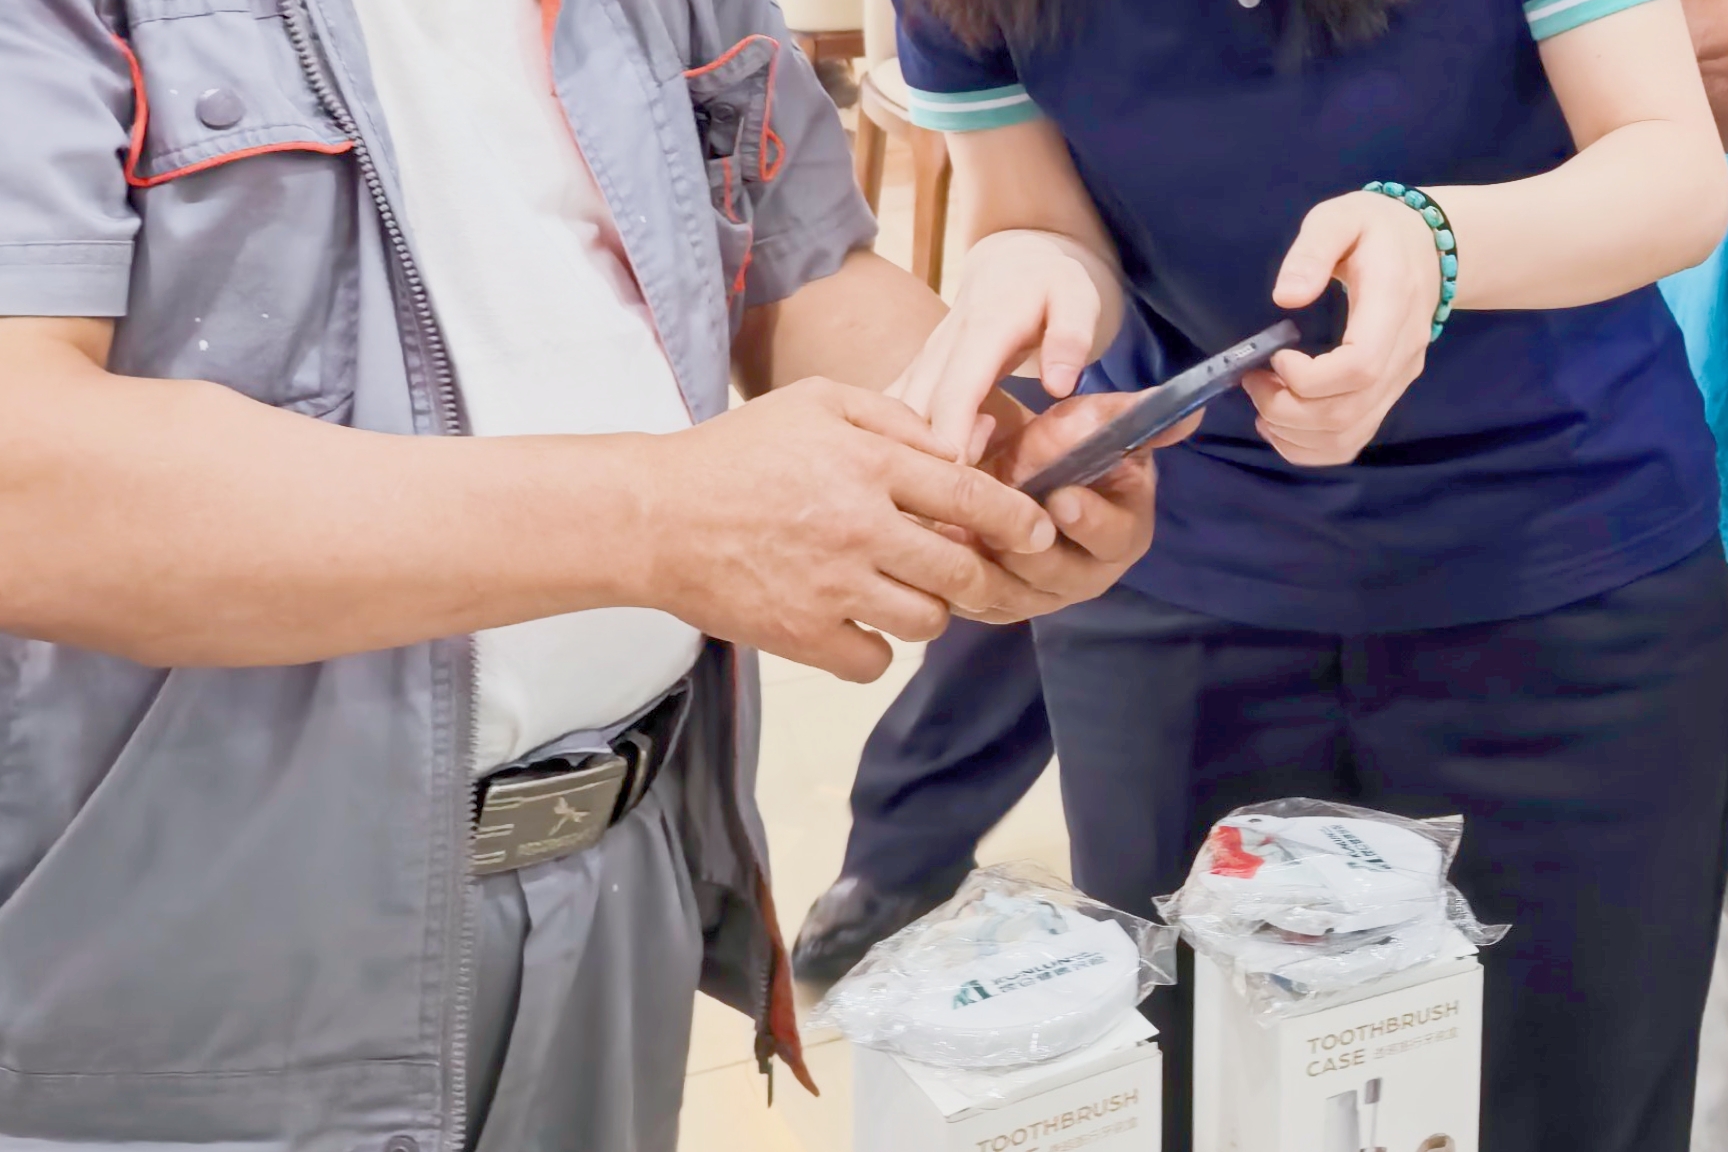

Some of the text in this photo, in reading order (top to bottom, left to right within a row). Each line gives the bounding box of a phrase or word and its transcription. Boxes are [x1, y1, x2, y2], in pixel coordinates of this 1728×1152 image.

[1306, 1000, 1459, 1054] TOOTHBRUSH
[1306, 1049, 1366, 1077] CASE
[976, 1088, 1139, 1152] TOOTHBRUSH
